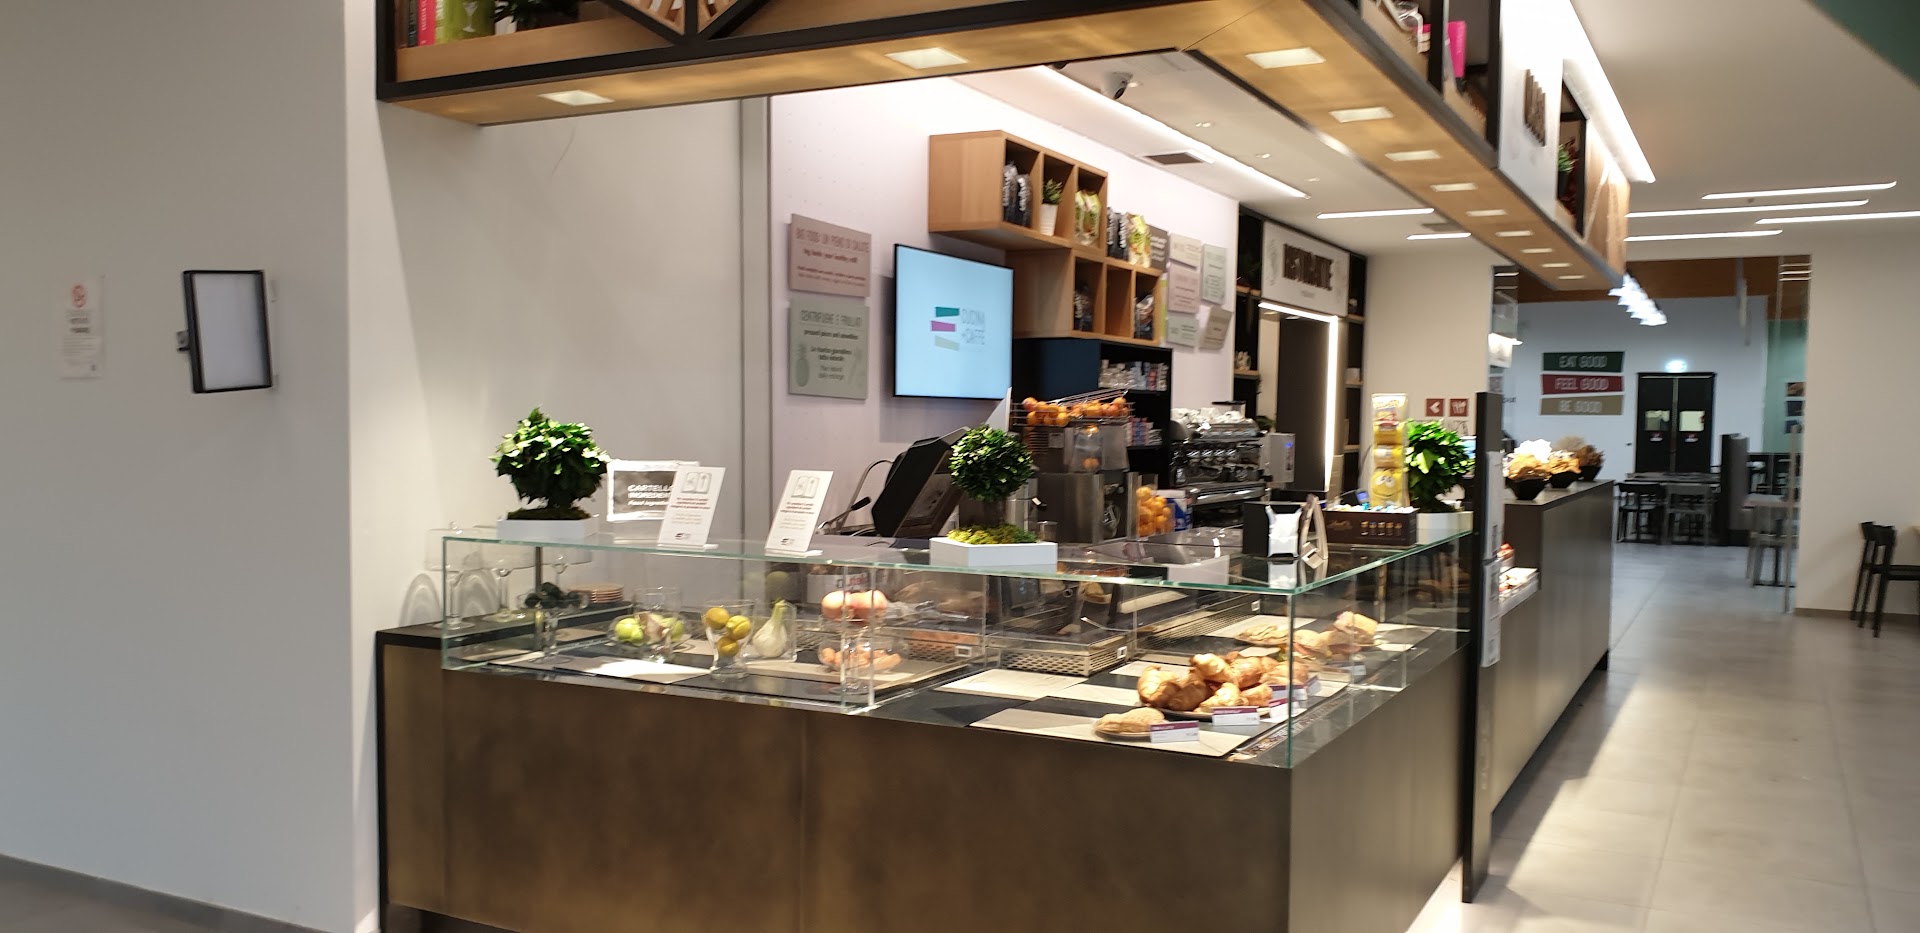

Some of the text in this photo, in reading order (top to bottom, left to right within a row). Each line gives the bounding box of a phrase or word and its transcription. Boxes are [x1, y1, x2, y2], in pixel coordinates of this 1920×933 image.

[1559, 355, 1607, 368] EAT GOOD
[1555, 377, 1609, 390] FEEL GOOD
[1559, 400, 1602, 413] BE GOOD
